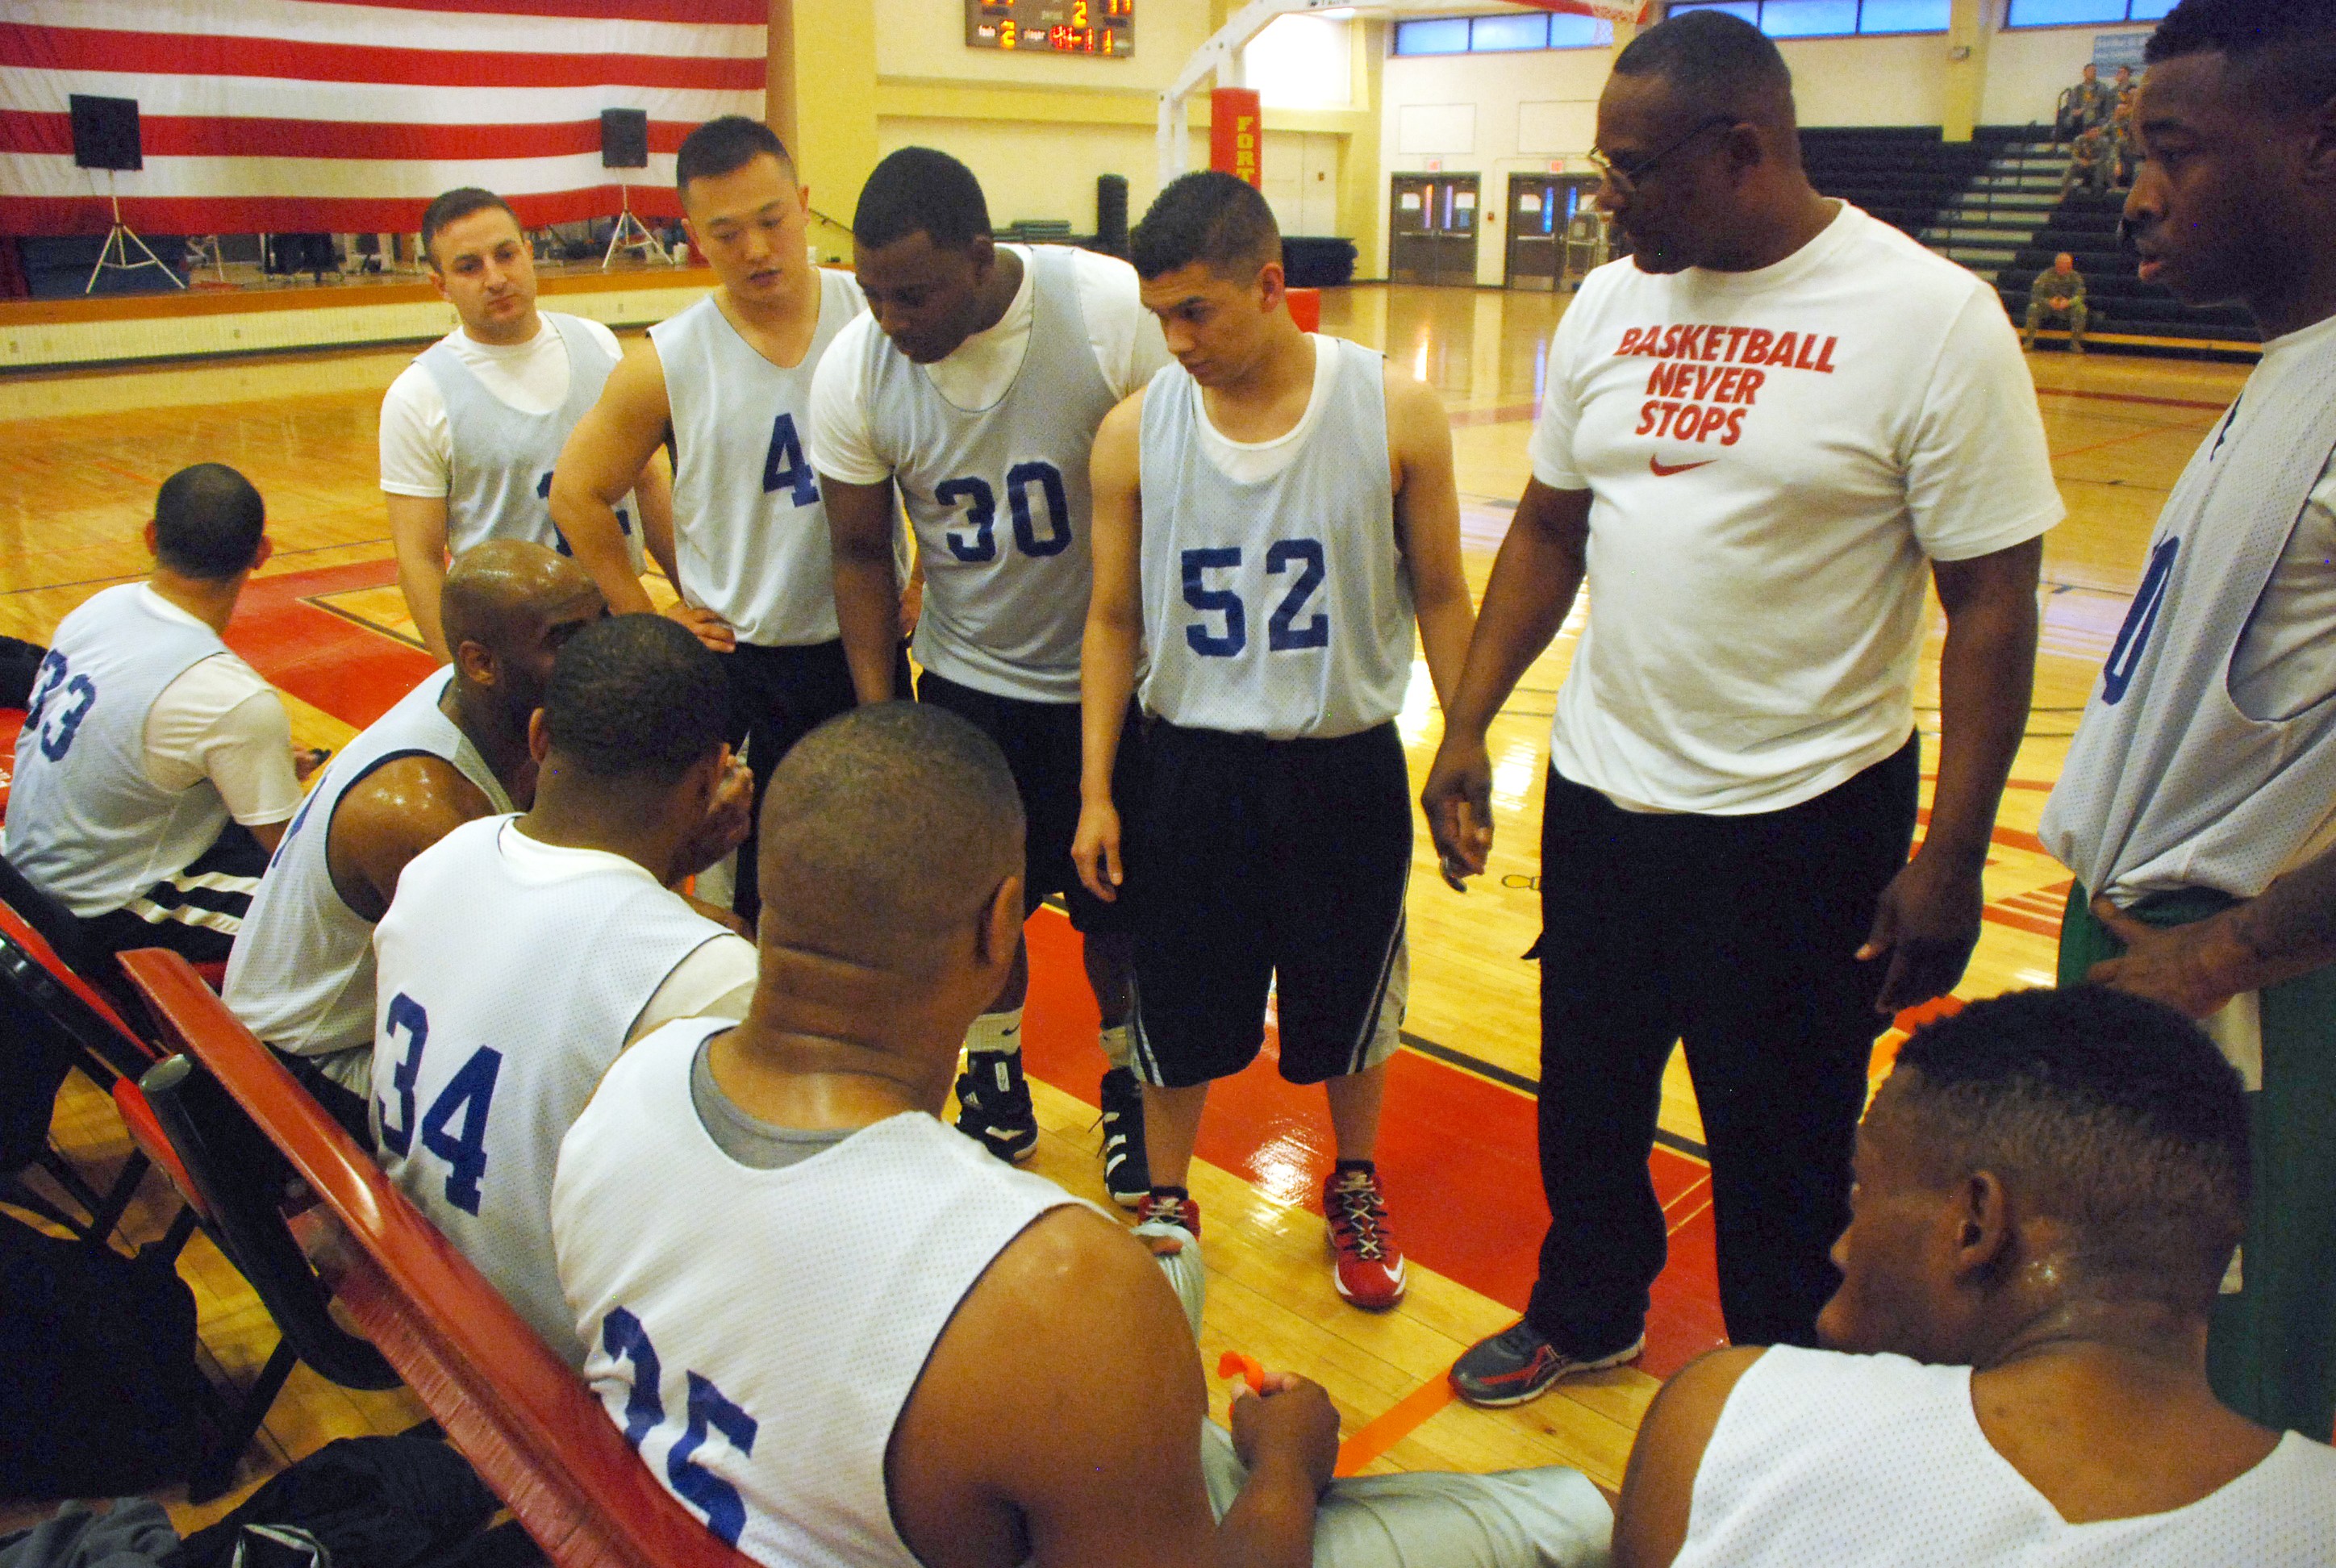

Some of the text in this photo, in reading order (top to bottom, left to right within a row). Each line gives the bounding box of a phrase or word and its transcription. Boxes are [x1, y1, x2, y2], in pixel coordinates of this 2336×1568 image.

[1000, 19, 1016, 50] 2
[1237, 115, 1255, 183] FORT
[1613, 323, 1839, 373] BASKETBALL
[1646, 362, 1766, 405] NEVER
[1635, 400, 1747, 446] STOPS
[762, 413, 820, 507] 4
[934, 461, 1072, 562] 30
[1181, 537, 1329, 657] 52
[378, 991, 503, 1218] 34
